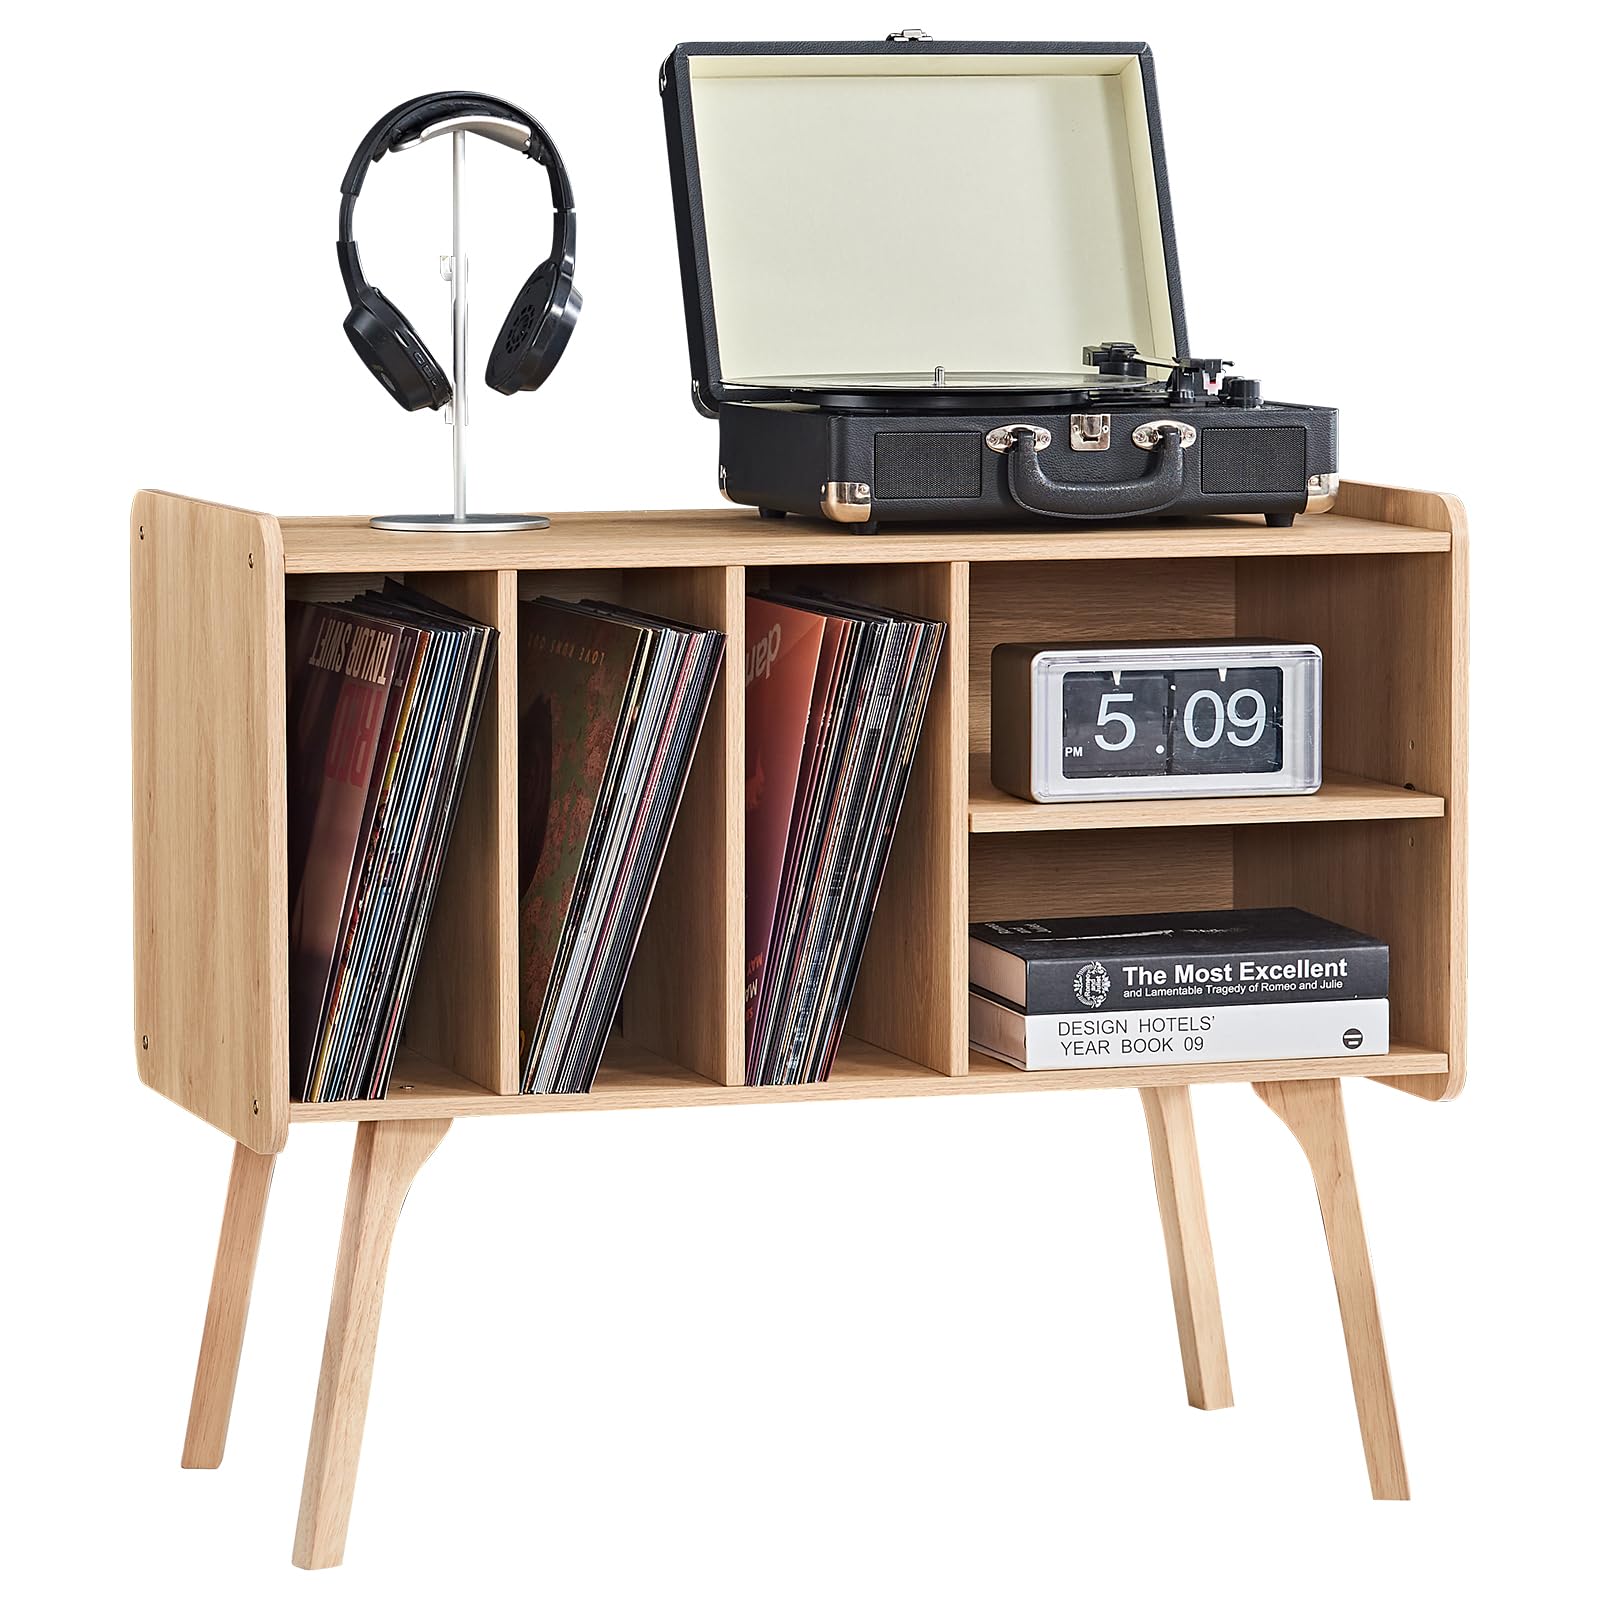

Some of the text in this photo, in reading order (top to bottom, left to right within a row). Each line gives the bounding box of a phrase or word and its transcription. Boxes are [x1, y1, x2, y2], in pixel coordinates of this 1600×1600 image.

[308, 617, 394, 686] TAYLOR SWIFT
[1094, 688, 1267, 751] 5 09
[1064, 746, 1083, 758] PM
[1122, 957, 1348, 986] The Most Excellent
[1123, 979, 1344, 998] and Lamentable Tragedy of Romeo and Julie
[1058, 1019, 1128, 1037] DESIGN
[1060, 1036, 1205, 1056] YEAR BOOK 09
